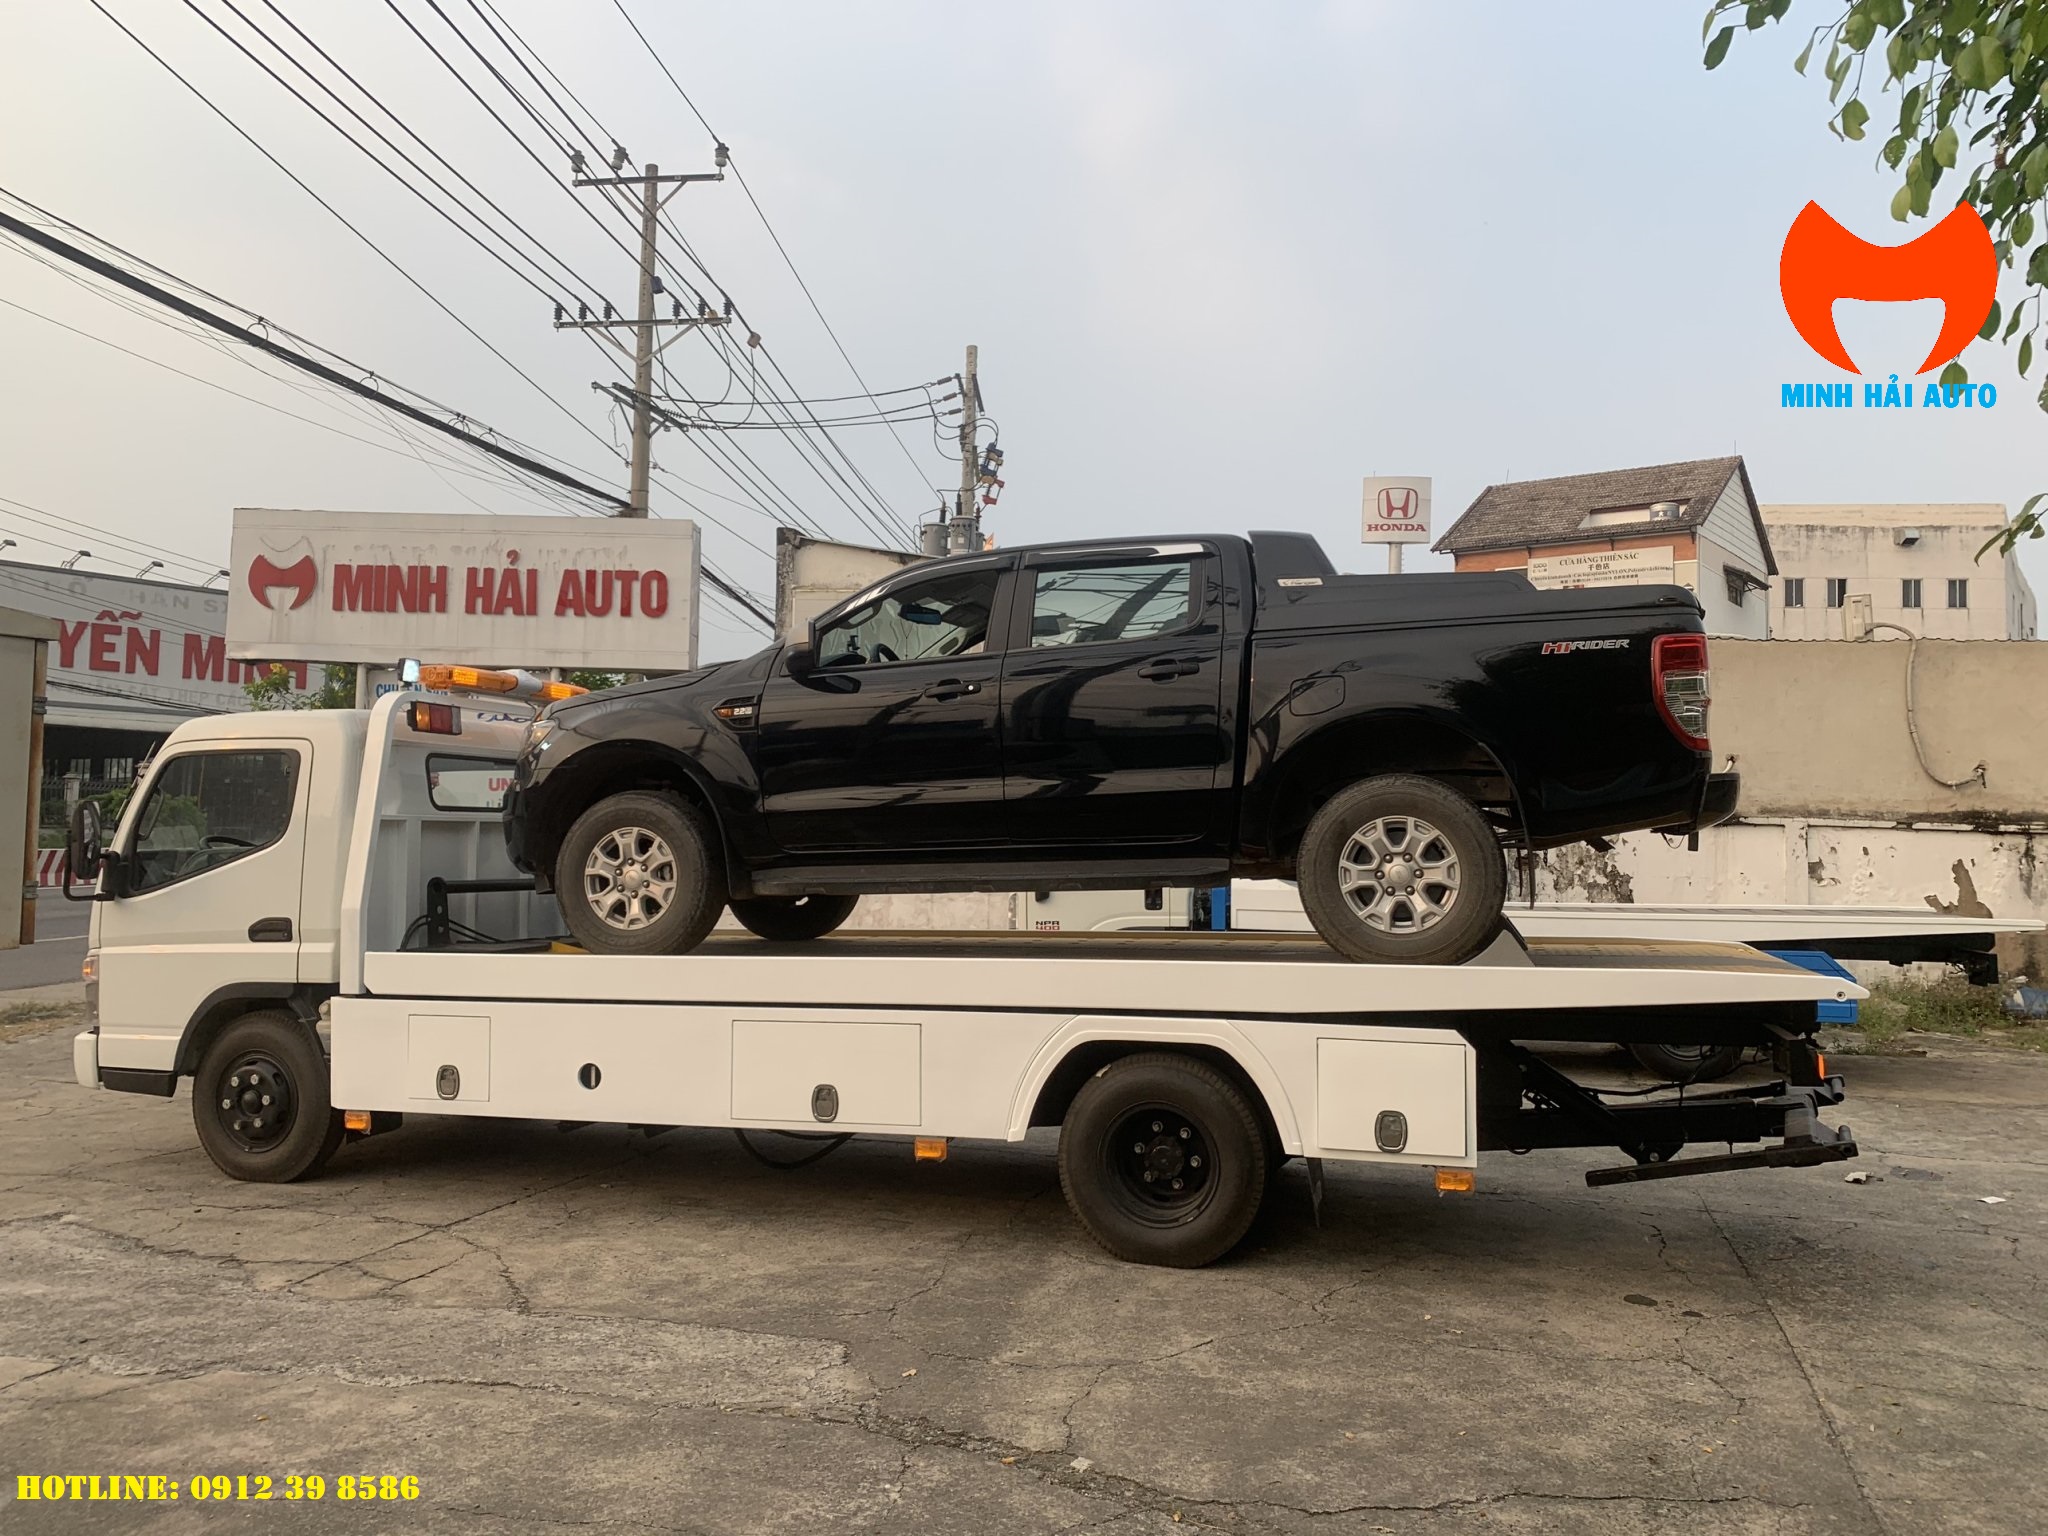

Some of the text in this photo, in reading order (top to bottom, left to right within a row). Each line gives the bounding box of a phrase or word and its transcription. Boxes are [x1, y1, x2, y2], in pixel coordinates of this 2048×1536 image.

[1367, 523, 1426, 532] HONDA
[333, 549, 669, 618] MINH HẢI AUTO
